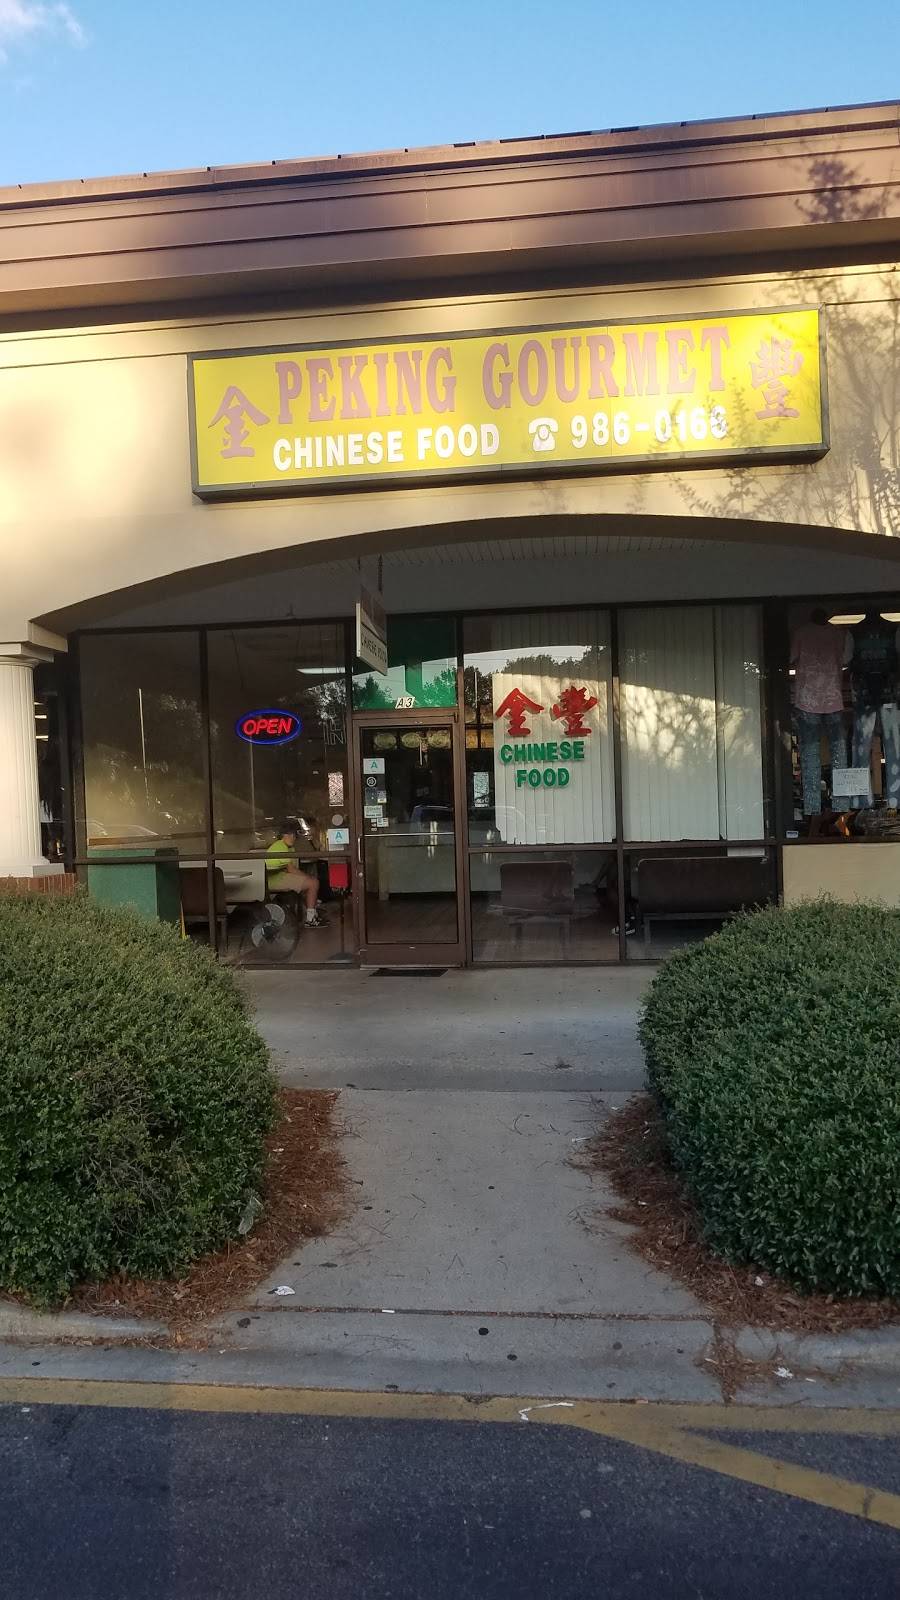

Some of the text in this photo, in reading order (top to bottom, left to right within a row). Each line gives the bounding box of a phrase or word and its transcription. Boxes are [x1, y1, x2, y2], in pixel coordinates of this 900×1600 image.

[275, 327, 730, 425] PEKING GOURMET
[208, 385, 271, 459] 金
[273, 430, 405, 472] CHINESE
[417, 424, 500, 461] FOOD
[243, 717, 293, 736] OPEN
[500, 740, 585, 763] CHINESE
[370, 760, 379, 769] A
[516, 767, 570, 788] FOOD
[334, 831, 343, 840] A
